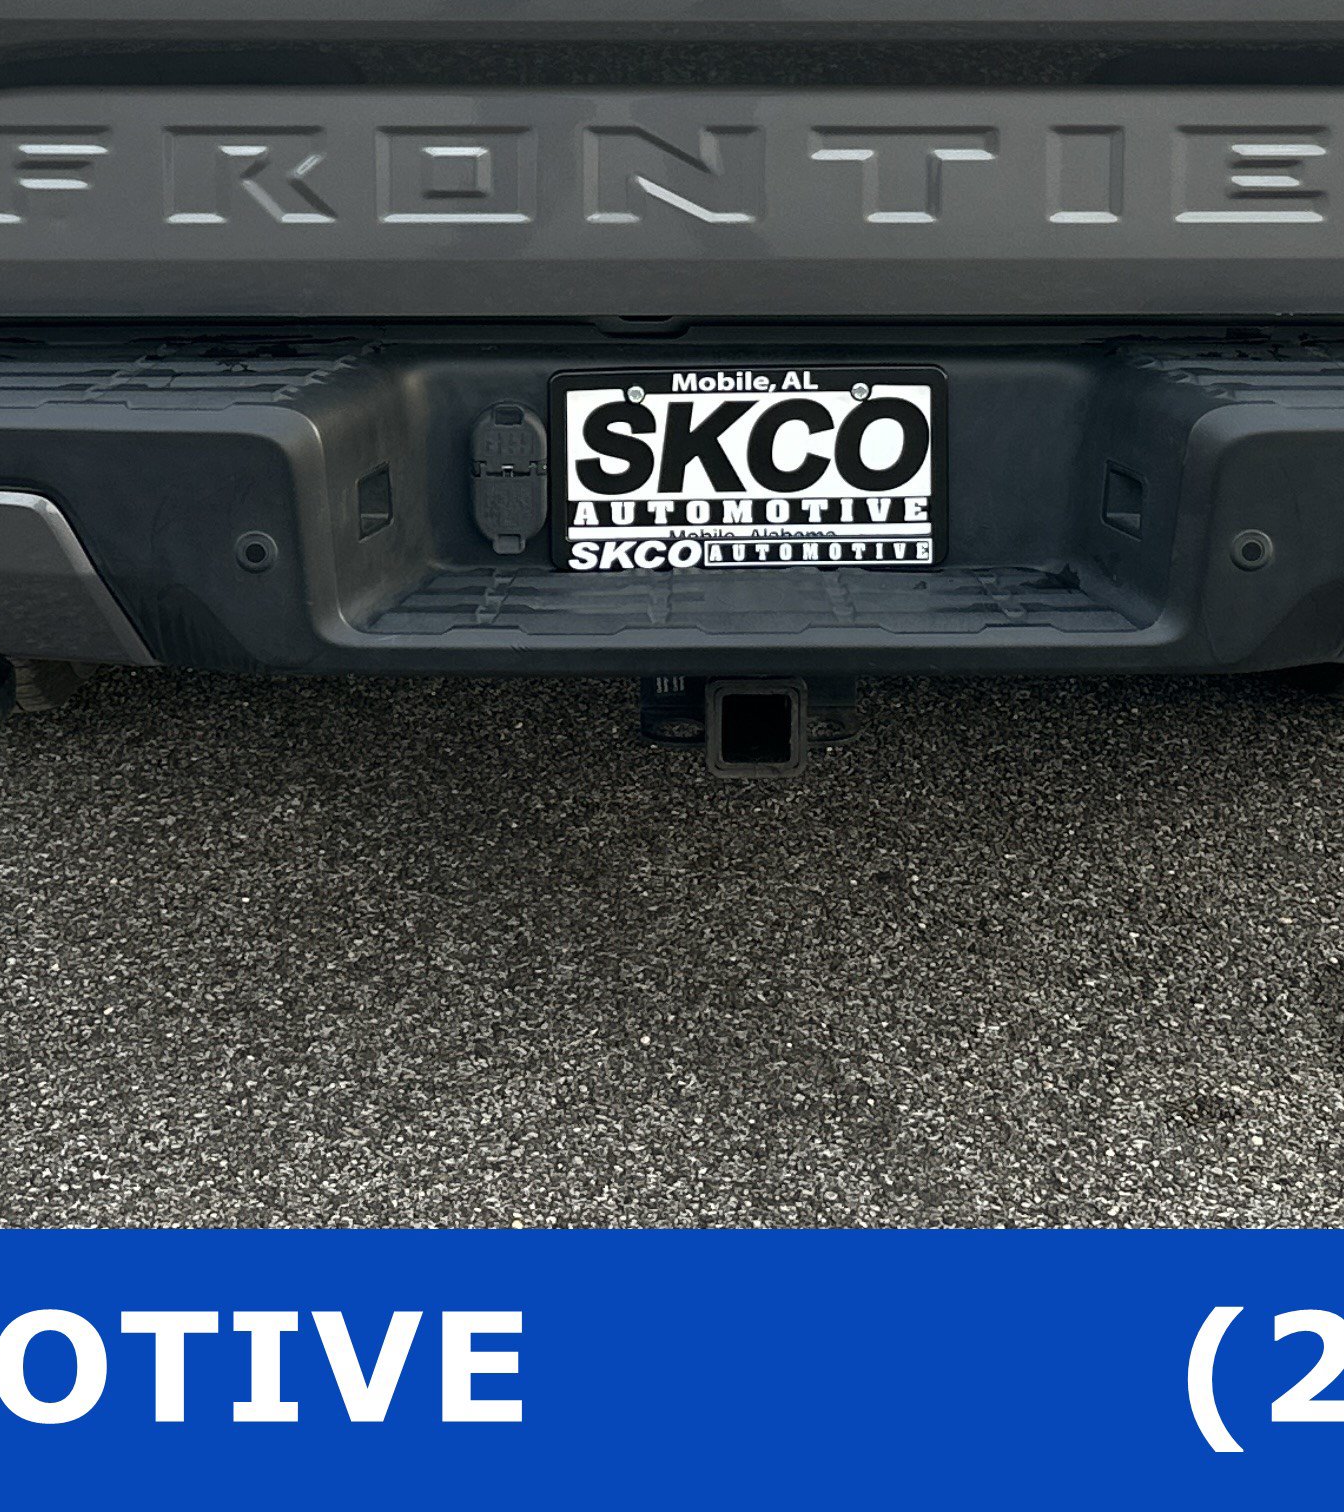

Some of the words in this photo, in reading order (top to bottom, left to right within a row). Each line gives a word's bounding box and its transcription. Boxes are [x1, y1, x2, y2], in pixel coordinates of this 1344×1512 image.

[671, 370, 777, 394] Mobile,
[781, 370, 819, 390] AL
[574, 396, 930, 496] SKCO
[573, 497, 929, 527] AUTOMOTIVE
[568, 540, 702, 570] SKCO
[709, 541, 930, 563] AUTOMOTIVE
